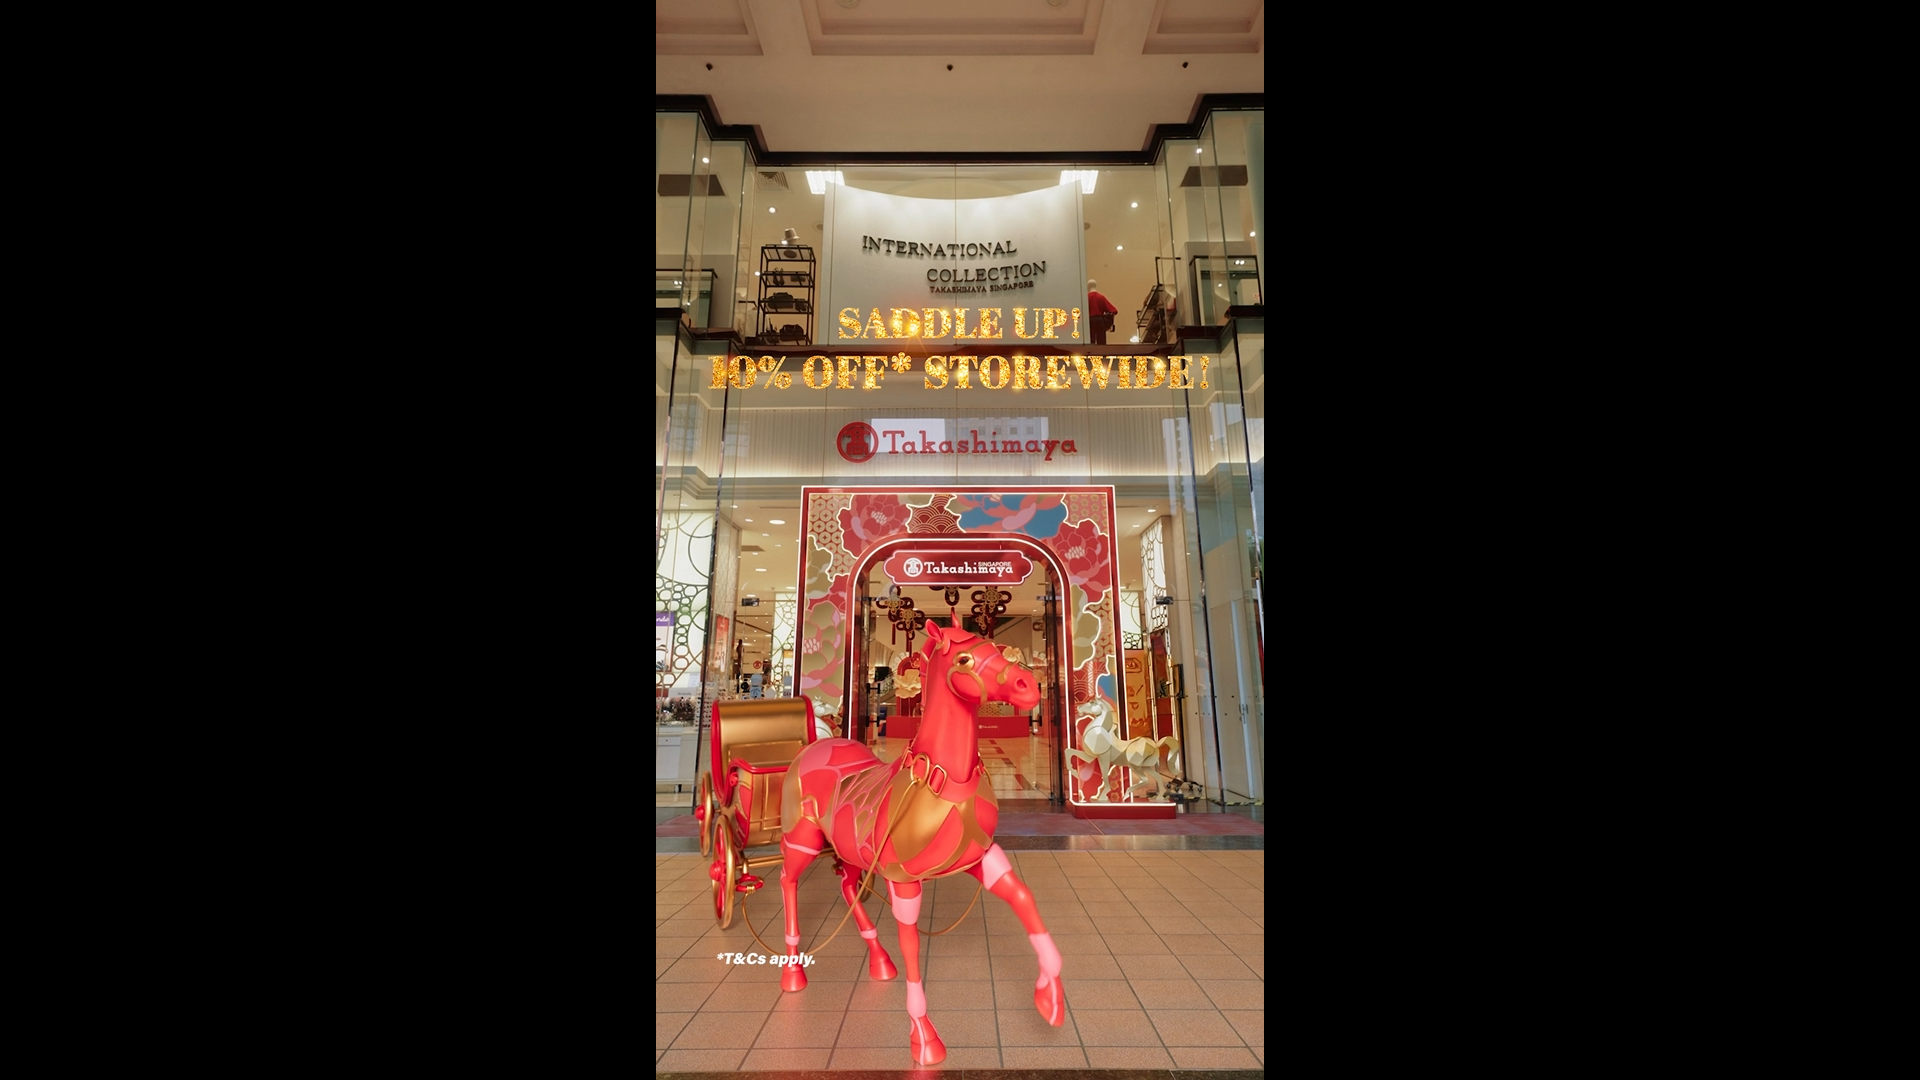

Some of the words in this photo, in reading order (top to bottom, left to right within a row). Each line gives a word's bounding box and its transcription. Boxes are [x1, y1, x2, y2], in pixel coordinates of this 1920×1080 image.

[862, 235, 1017, 257] INTERNATIONAL
[927, 261, 1046, 283] COLLECTION
[989, 281, 1034, 292] SINGAPORE
[882, 430, 1078, 461] Takashimaya
[924, 562, 1014, 577] Takashimaya
